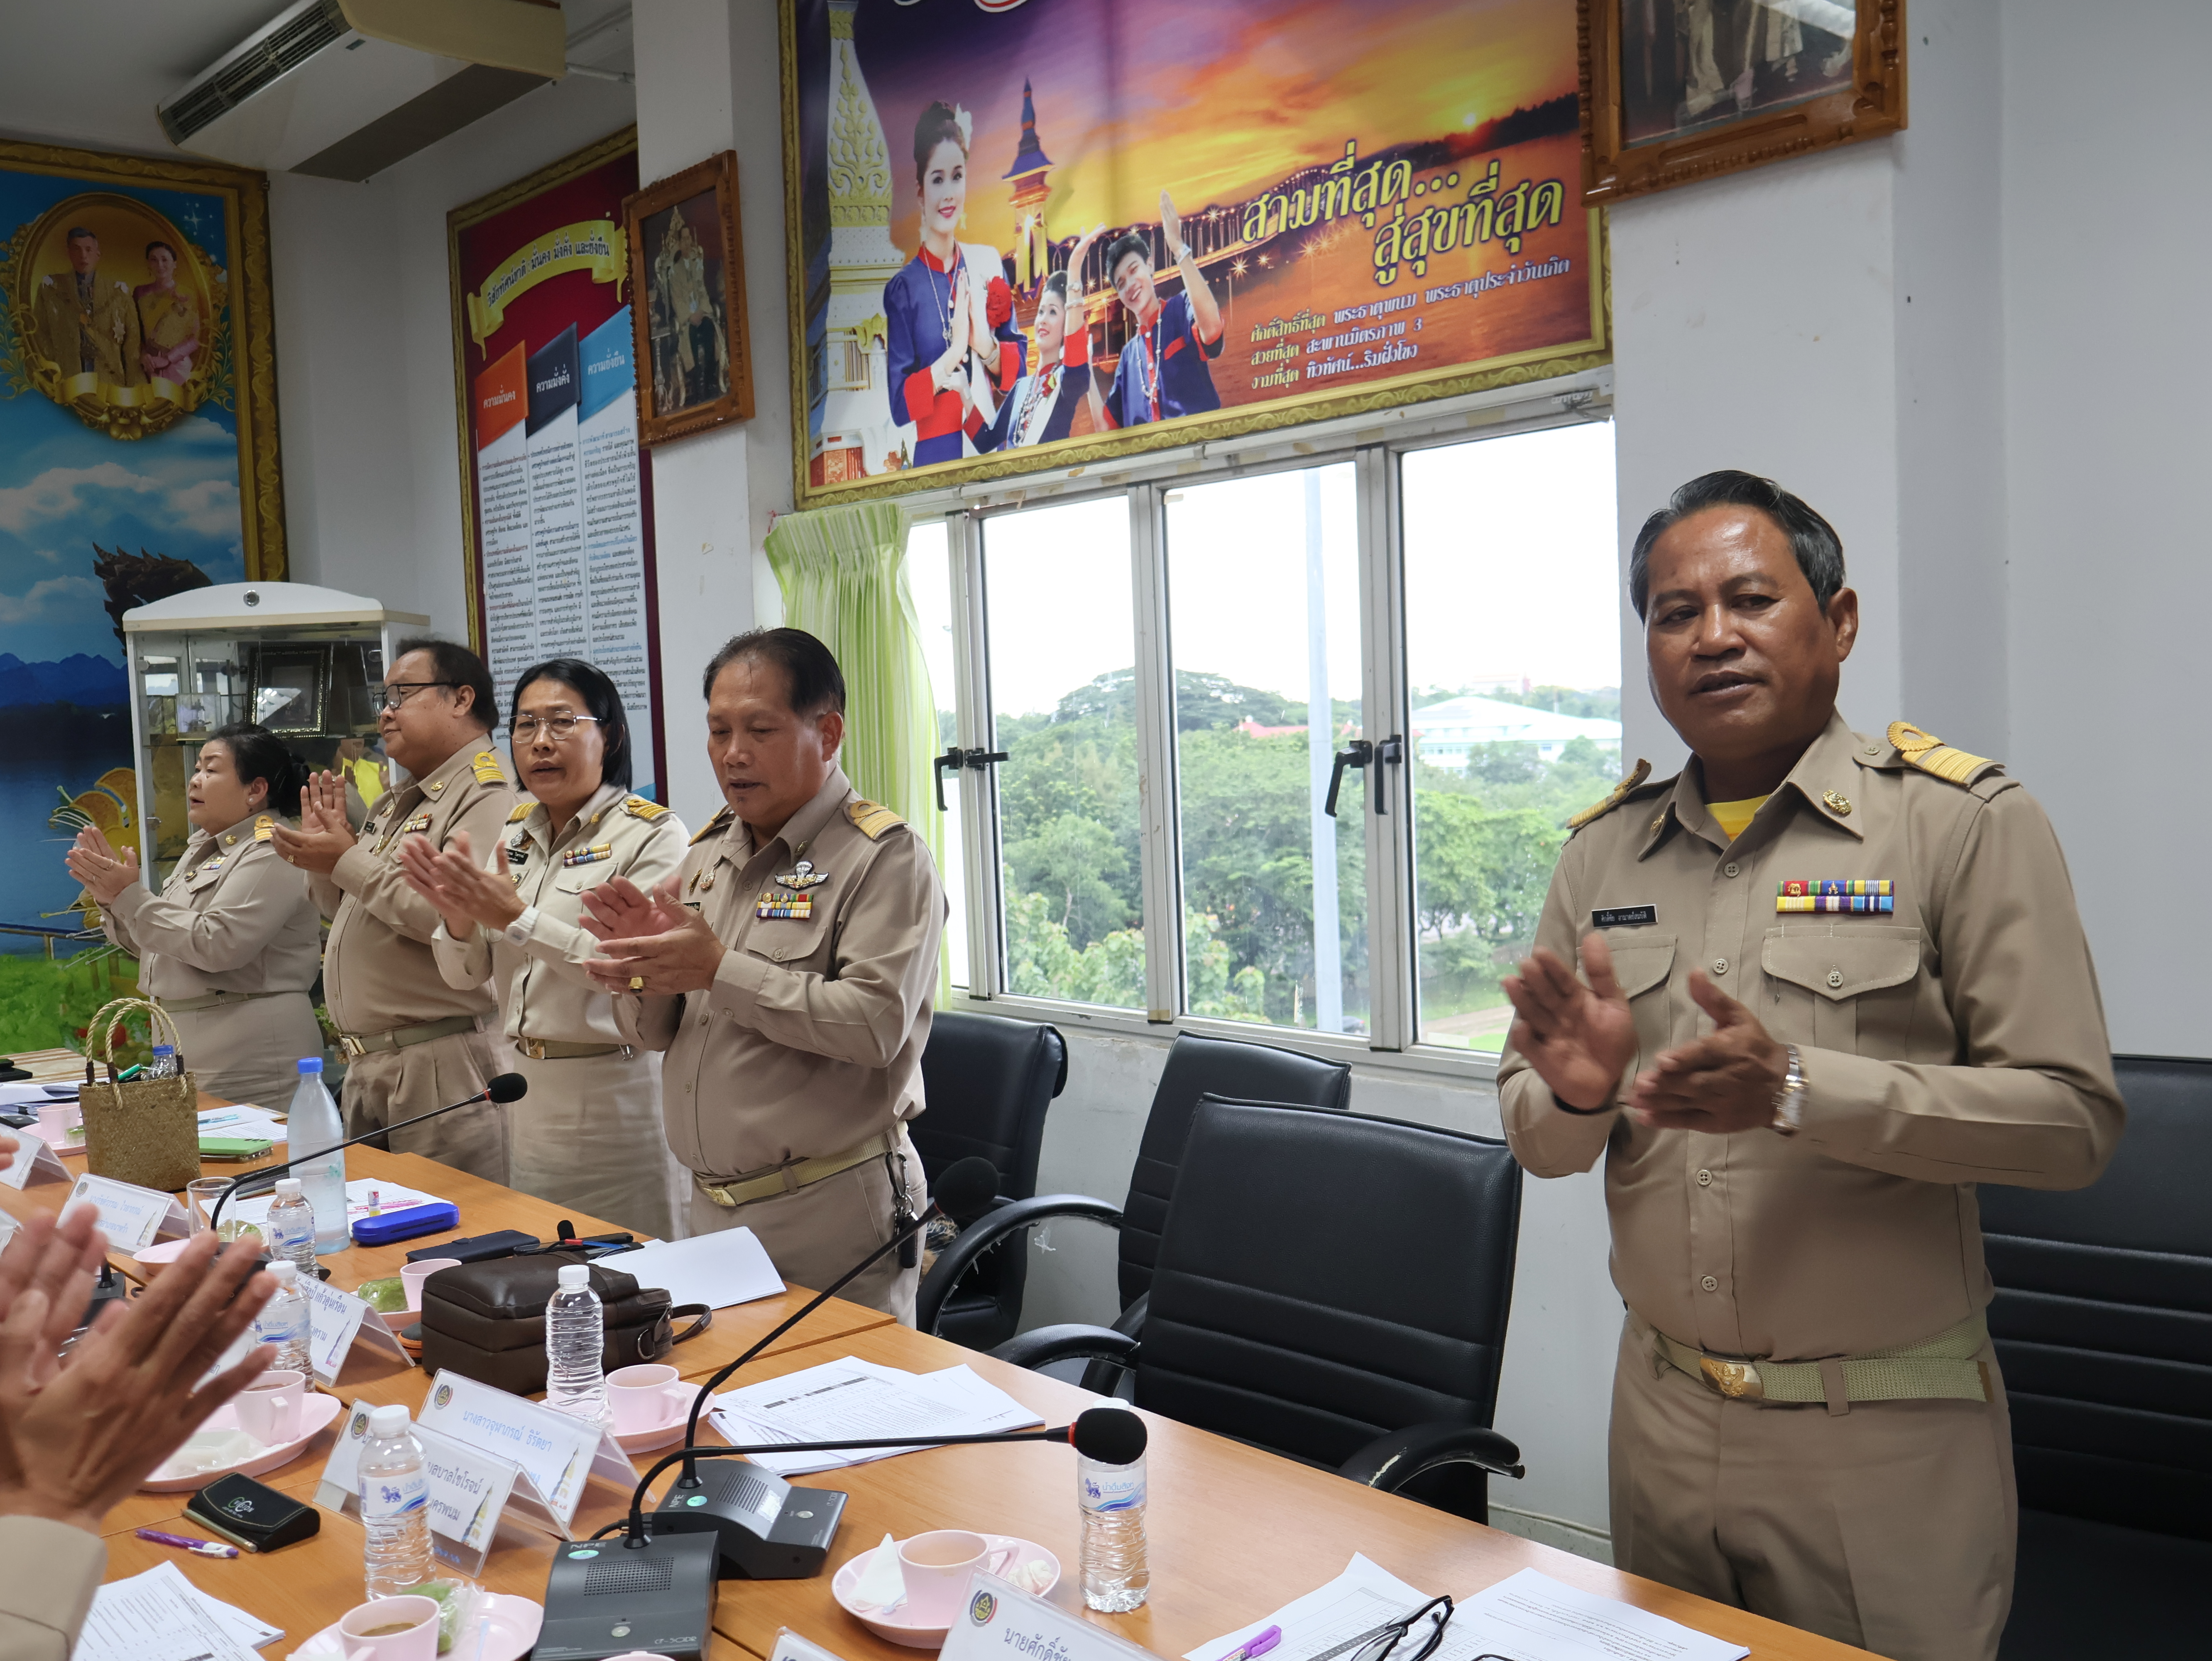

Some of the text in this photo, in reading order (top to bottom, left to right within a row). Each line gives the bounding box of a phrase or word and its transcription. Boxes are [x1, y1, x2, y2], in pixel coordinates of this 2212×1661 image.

[1243, 140, 1459, 243] สามที่สุด...
[1373, 159, 1564, 286] สู่สุขที่สุด
[1251, 255, 1570, 343] ศักดิ์สิทธิ์ที่สุด พระธาตุพนม พระธาตุประจำวันเกิด
[1251, 317, 1423, 365] สวยที่สุด สะพานมิตรภาพ 3
[587, 347, 625, 375] ความยั่งยืน
[536, 364, 570, 393] ความมั่งคั่ง
[1251, 363, 1300, 389] งามที่สุด
[484, 385, 516, 409] ความมั่นคง
[668, 1494, 684, 1507] NPE
